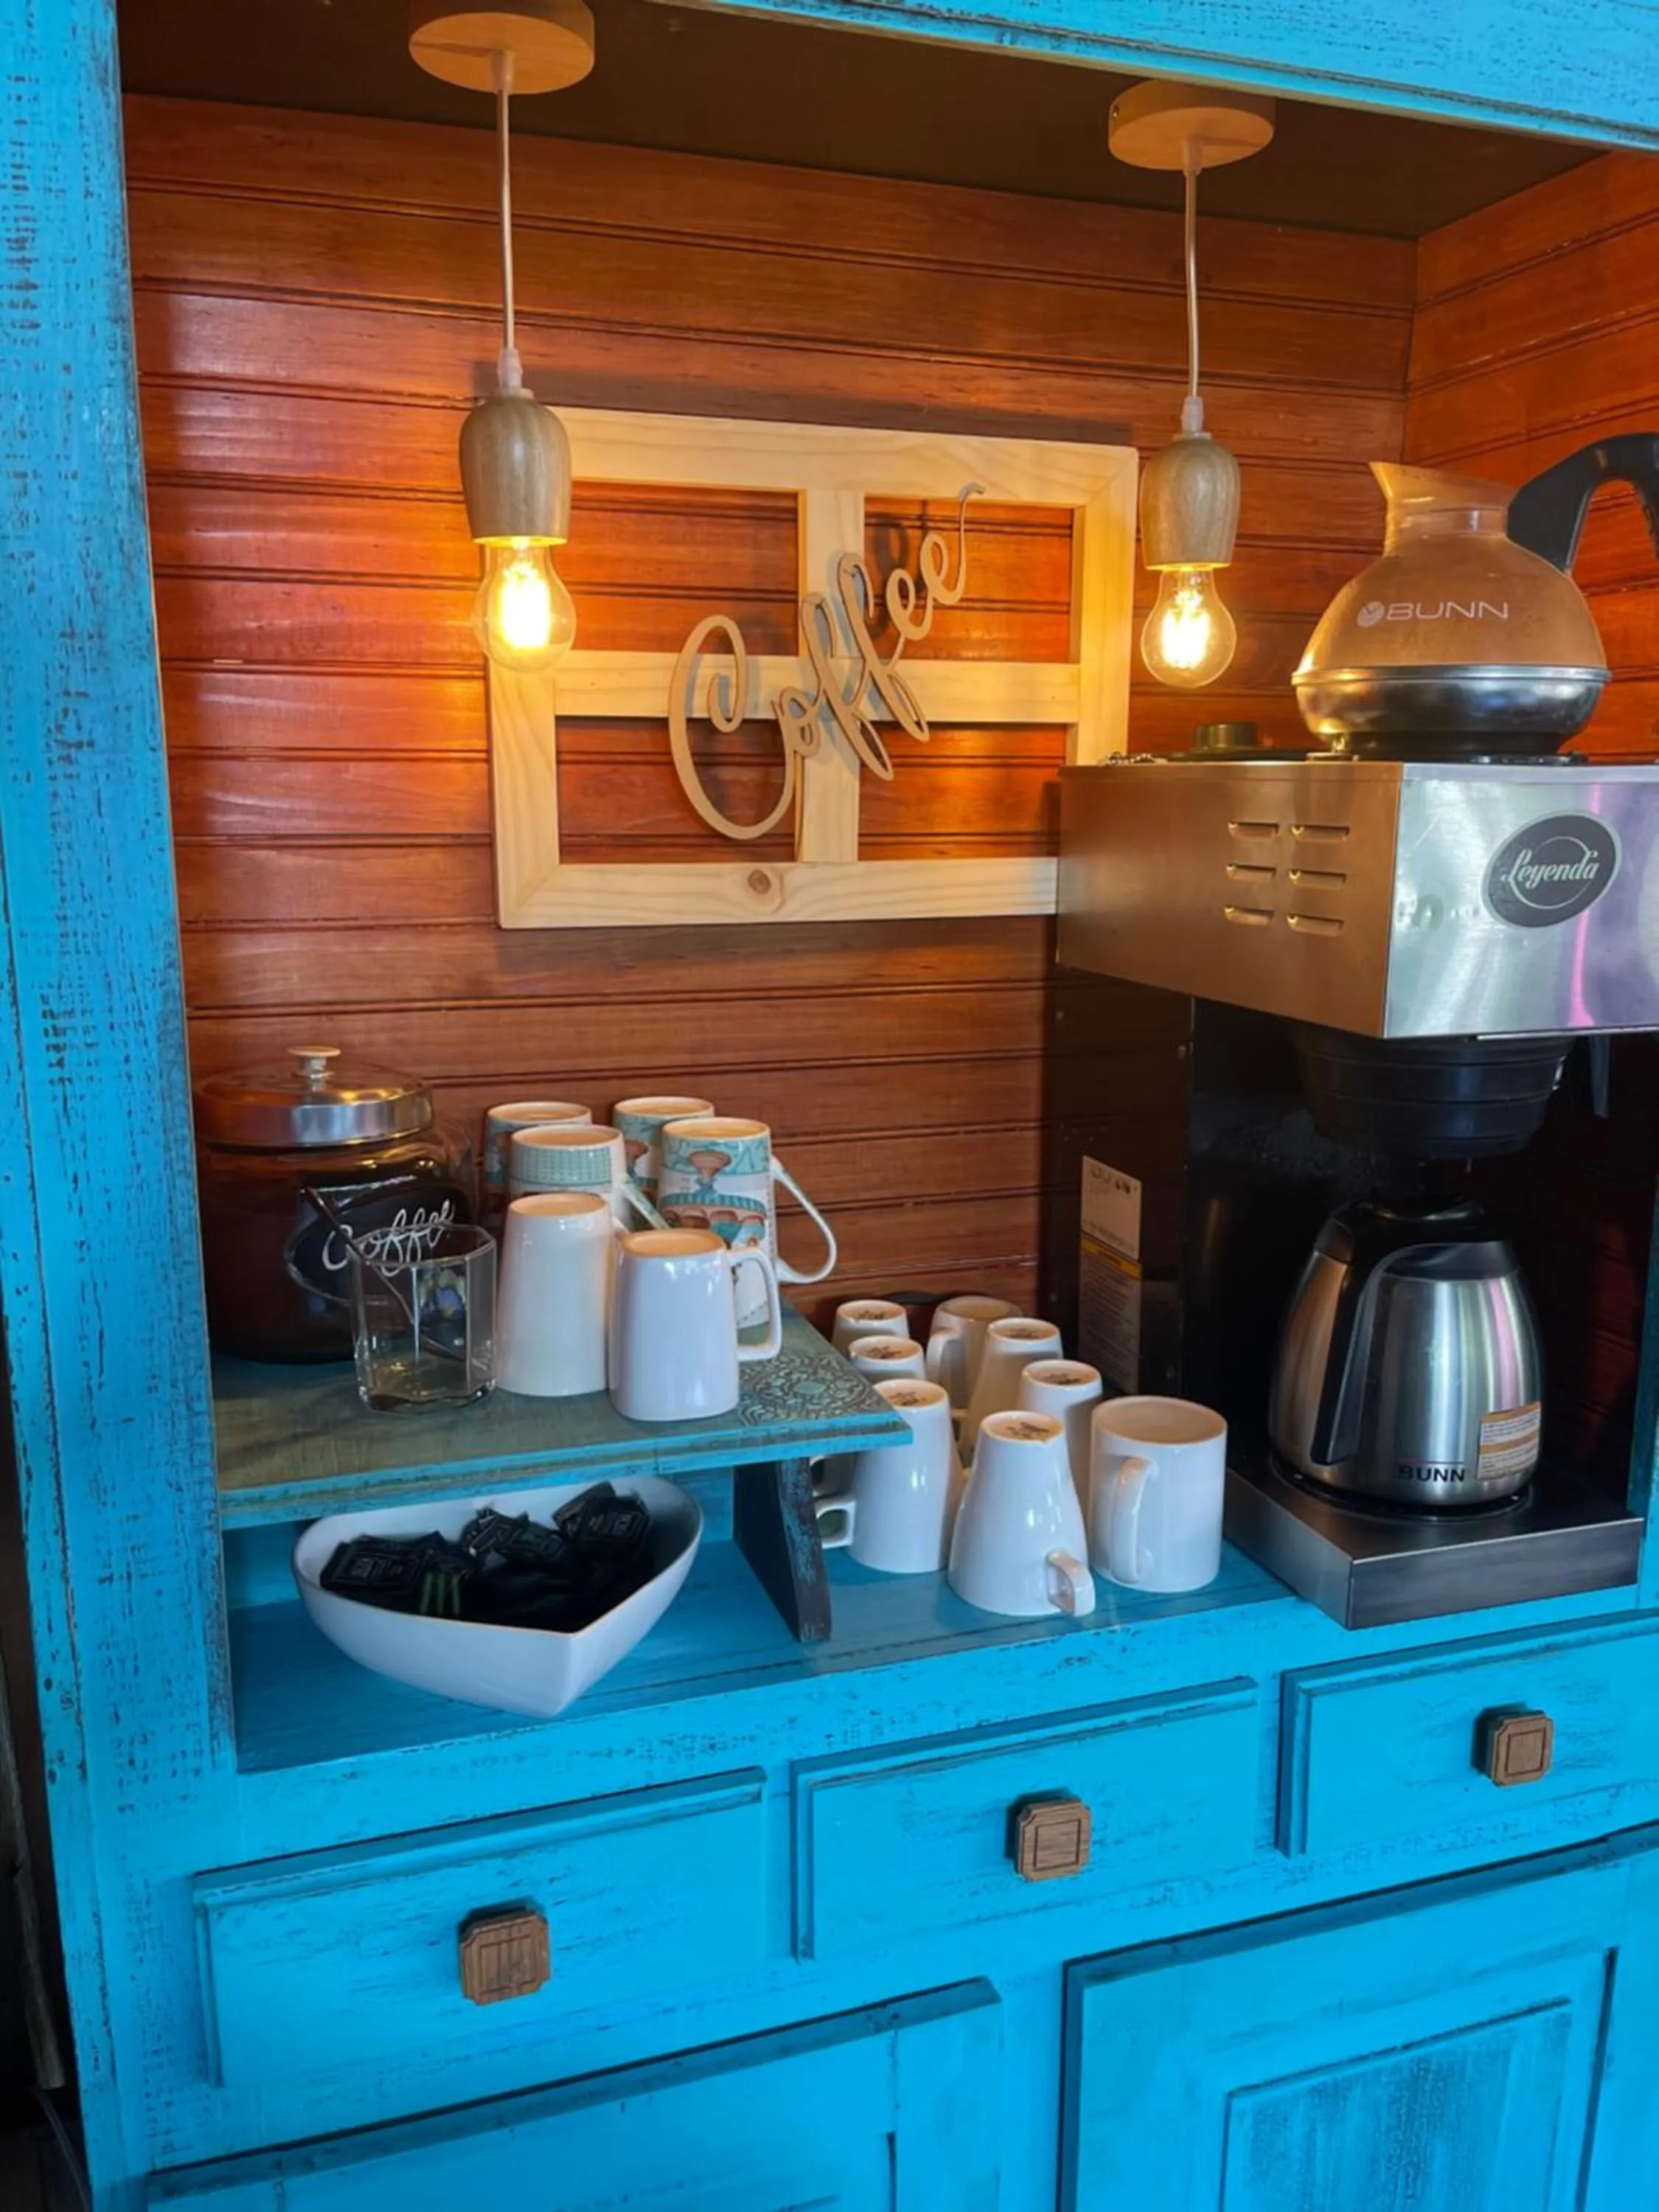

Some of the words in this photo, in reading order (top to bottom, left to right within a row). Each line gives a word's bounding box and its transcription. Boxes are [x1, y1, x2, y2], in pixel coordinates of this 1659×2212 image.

[1386, 601, 1509, 621] BUNN
[668, 483, 987, 841] Coffee
[1500, 848, 1599, 889] Leyenda
[321, 1198, 455, 1277] Coffee
[1398, 1465, 1466, 1483] BUNN
